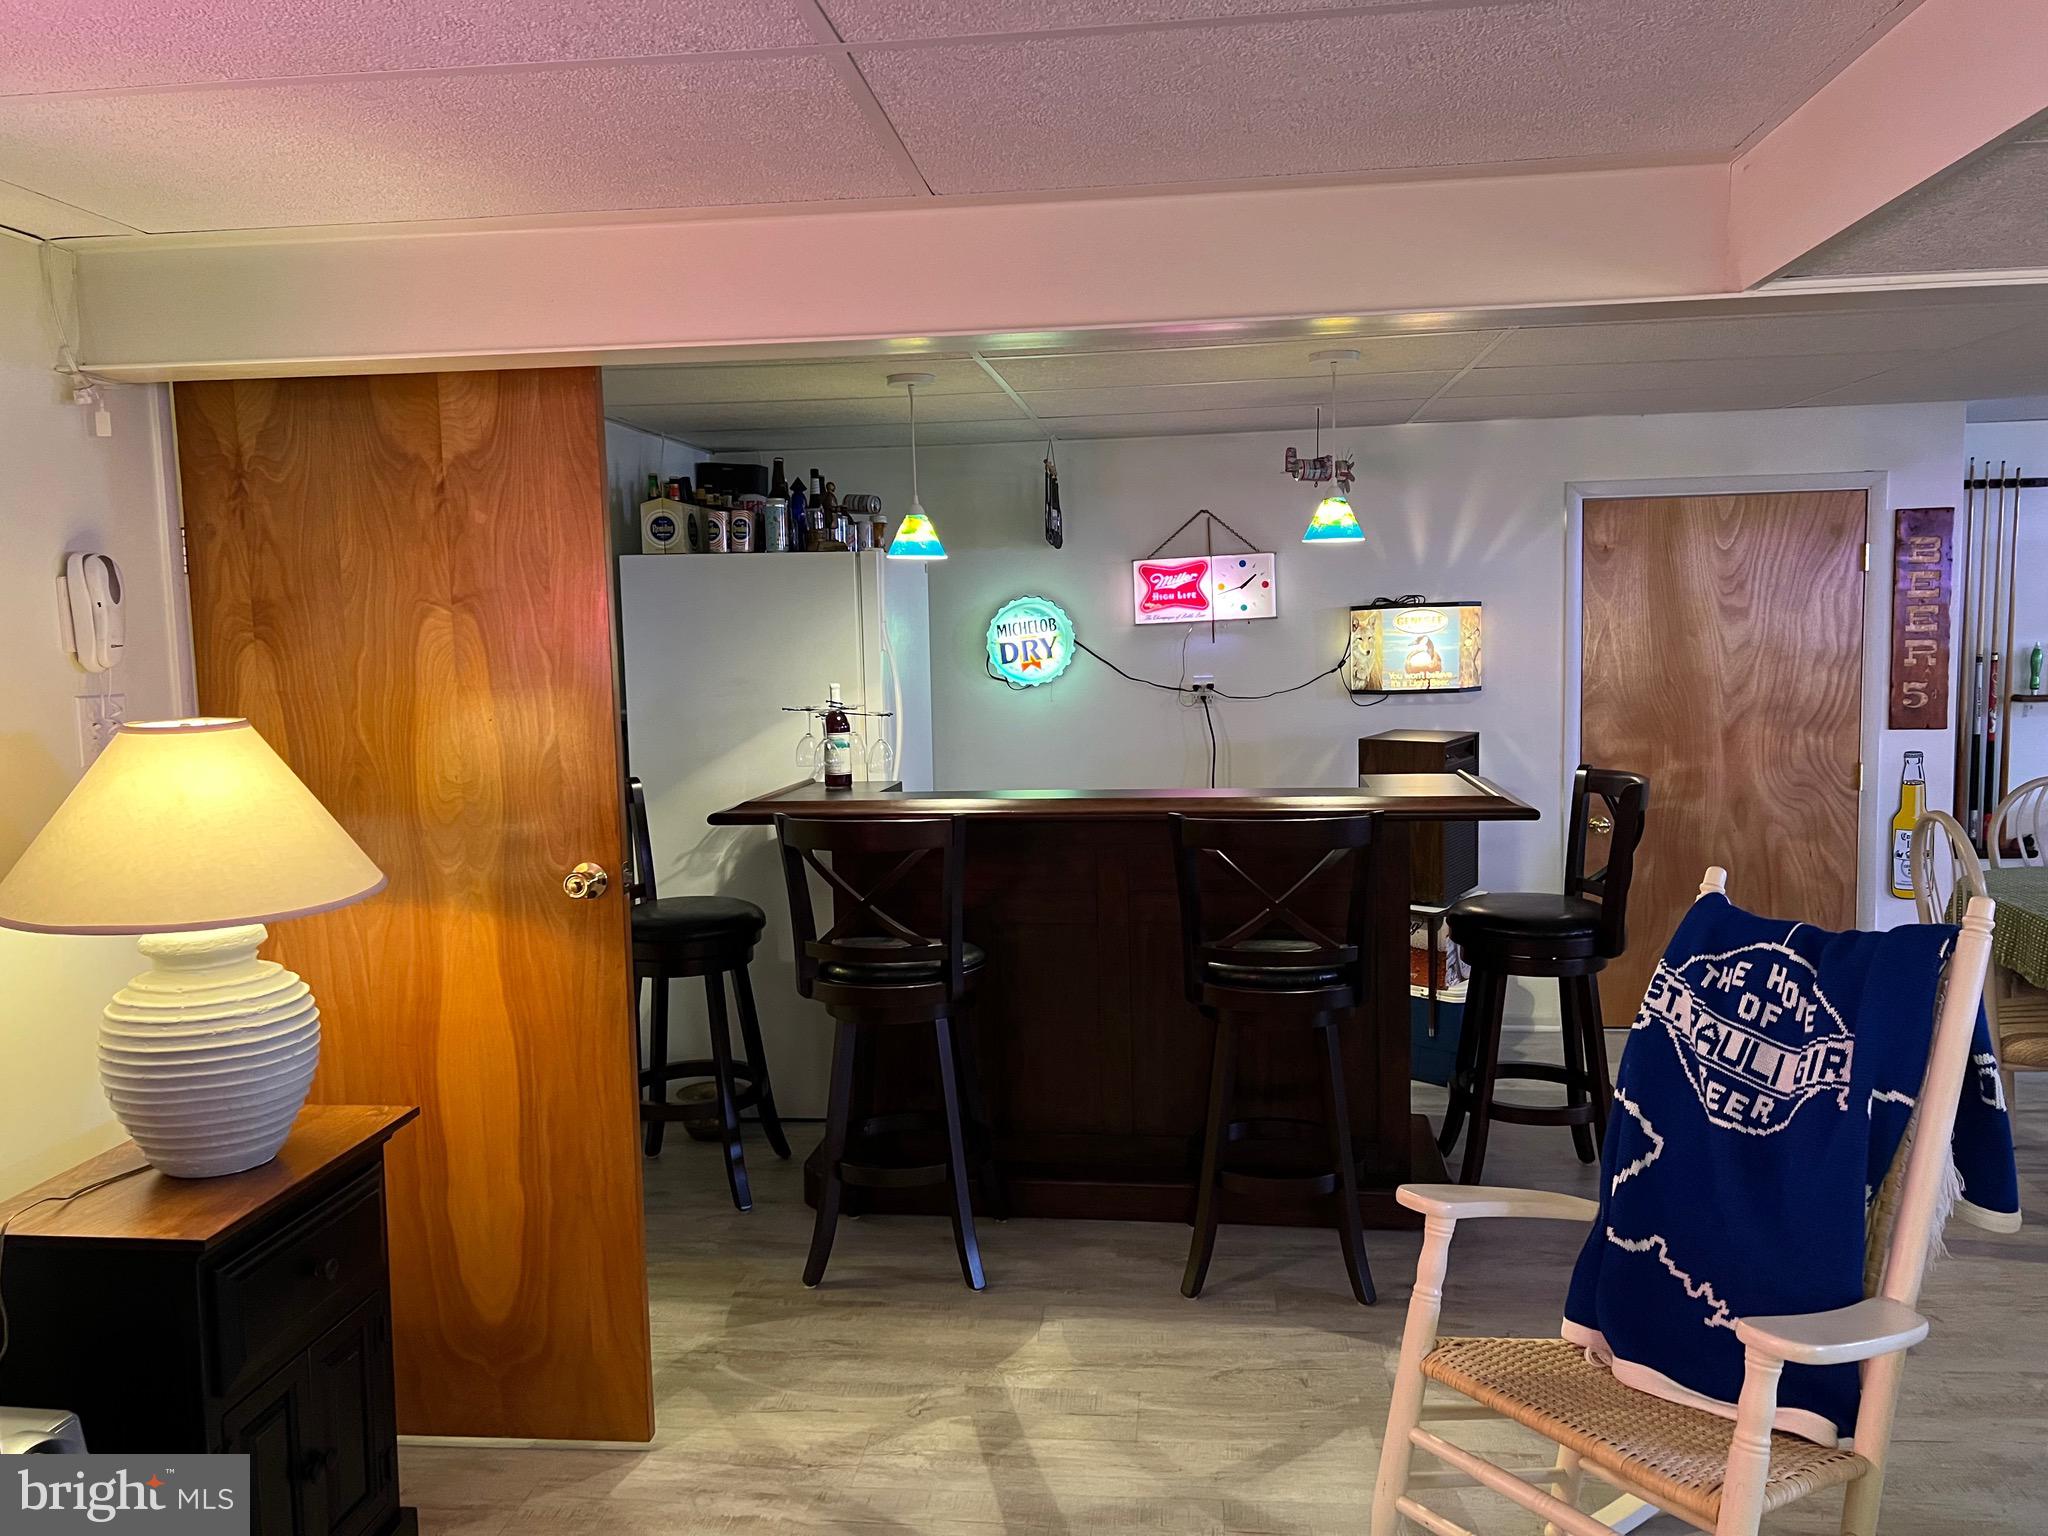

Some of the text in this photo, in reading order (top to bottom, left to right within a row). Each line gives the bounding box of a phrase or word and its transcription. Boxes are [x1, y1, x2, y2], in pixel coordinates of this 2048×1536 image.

[1150, 572, 1198, 590] Miller
[1905, 536, 1942, 667] BEER
[996, 618, 1057, 638] MICHELOB
[1000, 636, 1057, 664] DRY
[1701, 961, 1753, 993] THE
[1737, 992, 1783, 1028] OF
[1690, 1007, 1786, 1088] AULI
[1699, 1064, 1775, 1124] EER
